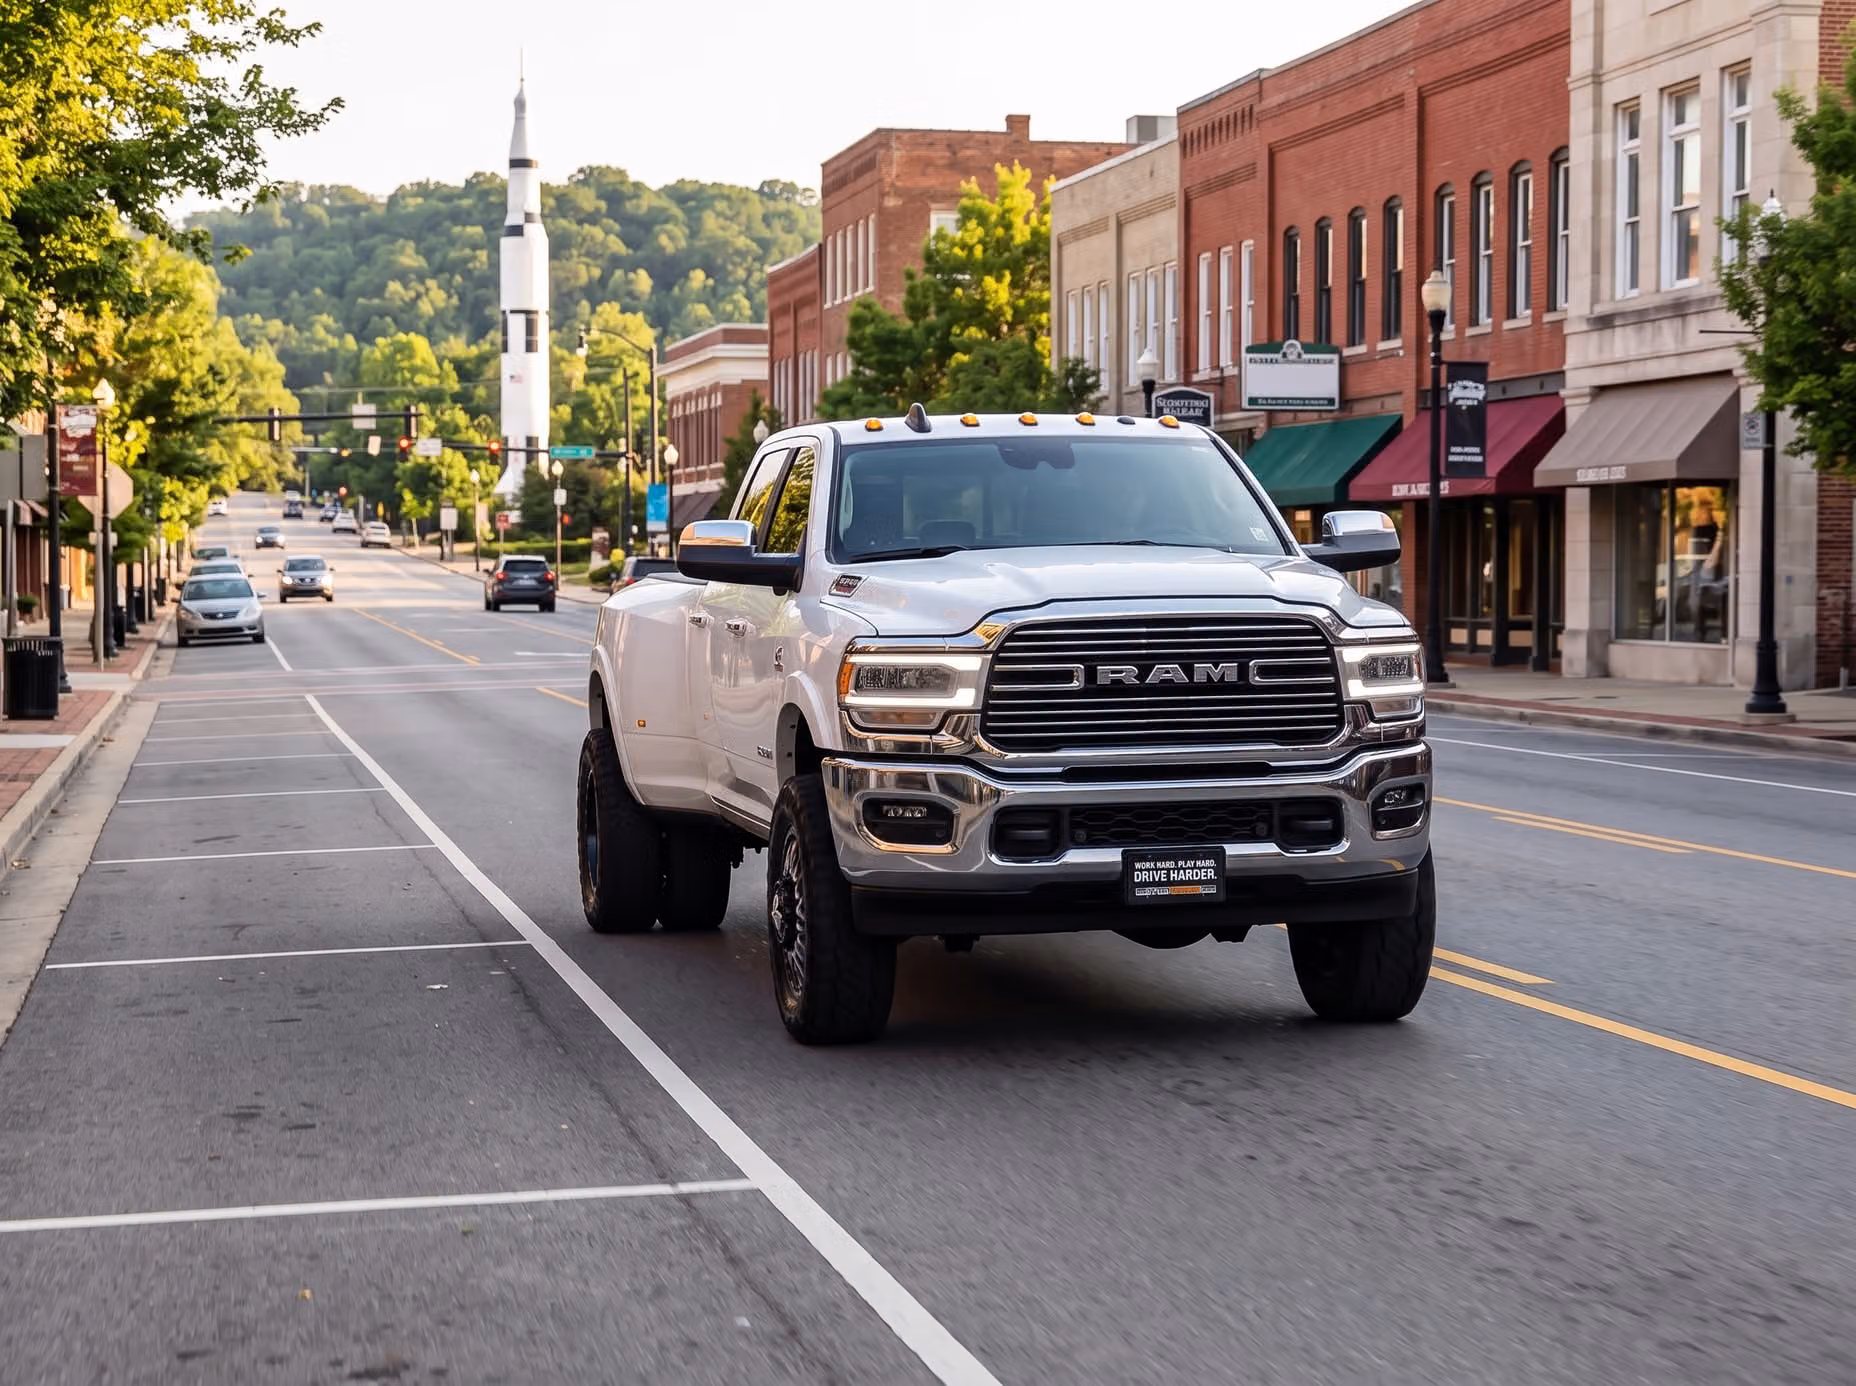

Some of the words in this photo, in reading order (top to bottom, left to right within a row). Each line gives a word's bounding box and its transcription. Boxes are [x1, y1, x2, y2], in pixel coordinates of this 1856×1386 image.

[1096, 663, 1239, 685] RAM
[1134, 861, 1156, 870] WORK
[1156, 860, 1177, 869] HARD.
[1178, 860, 1195, 868] PLAY
[1196, 859, 1217, 868] HARD.
[1134, 870, 1168, 882] DRIVE
[1170, 868, 1218, 880] HARDER.
